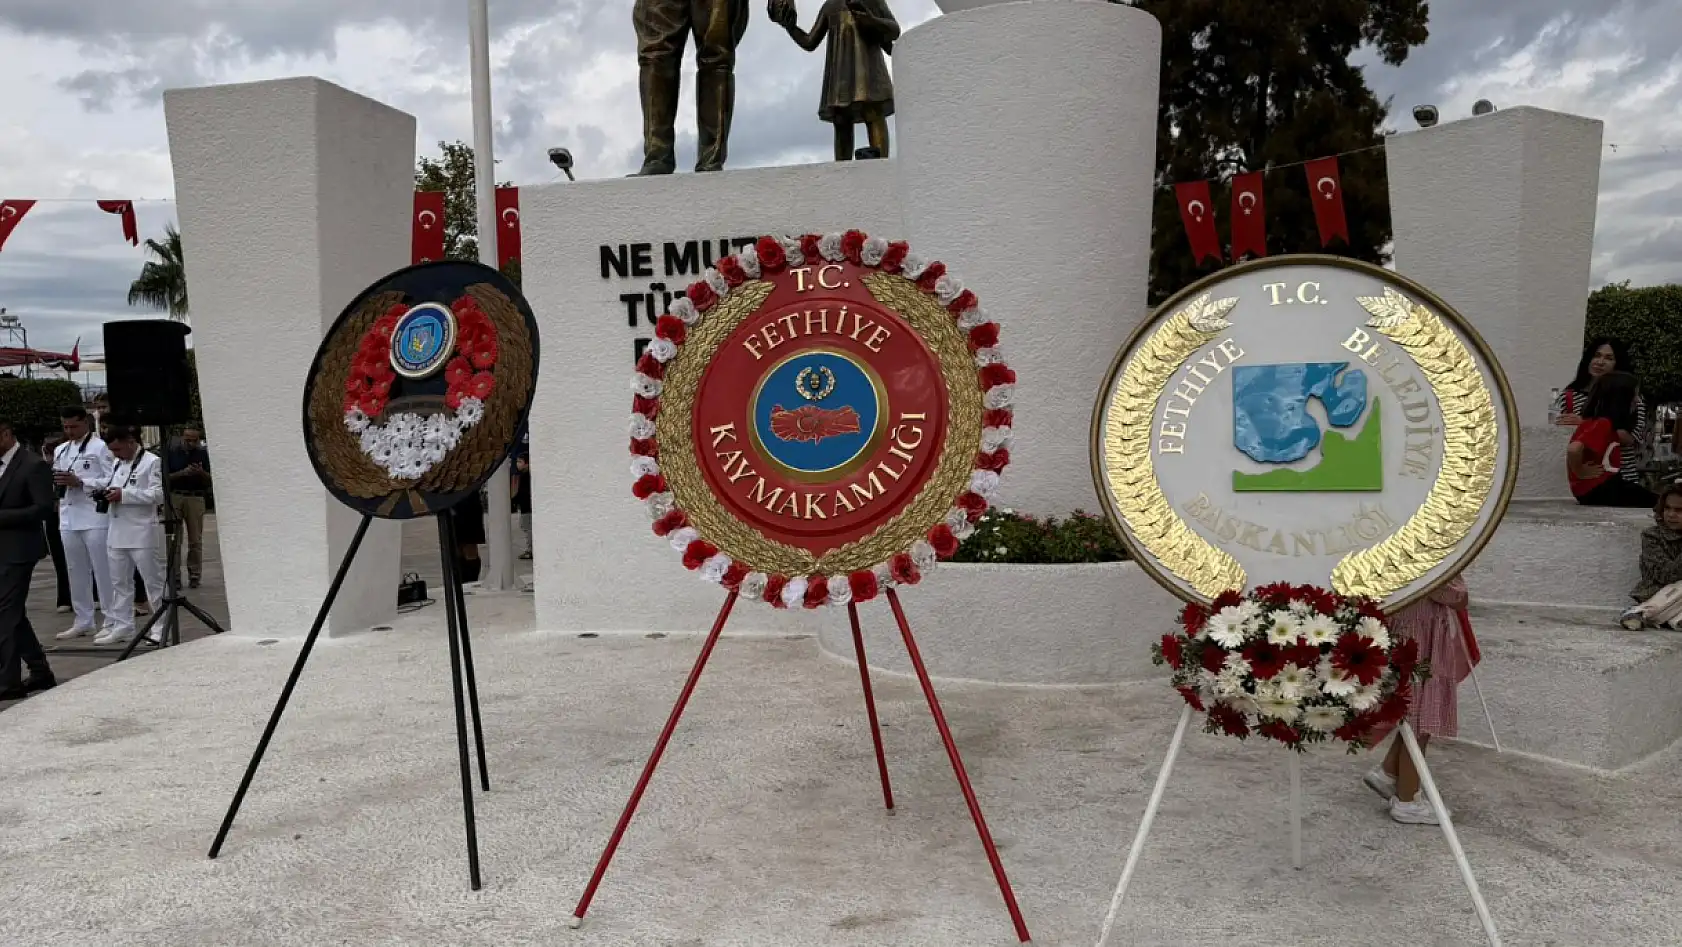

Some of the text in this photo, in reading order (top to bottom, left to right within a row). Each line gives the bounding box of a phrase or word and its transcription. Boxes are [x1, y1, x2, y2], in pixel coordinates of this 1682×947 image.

[600, 243, 653, 278] NE
[789, 264, 850, 292] T.C.
[1263, 281, 1329, 306] T.C.
[742, 305, 892, 361] FETHİYE
[1159, 338, 1246, 455] FETHİYE
[710, 412, 927, 521] KAYMAKAMLIĞI
